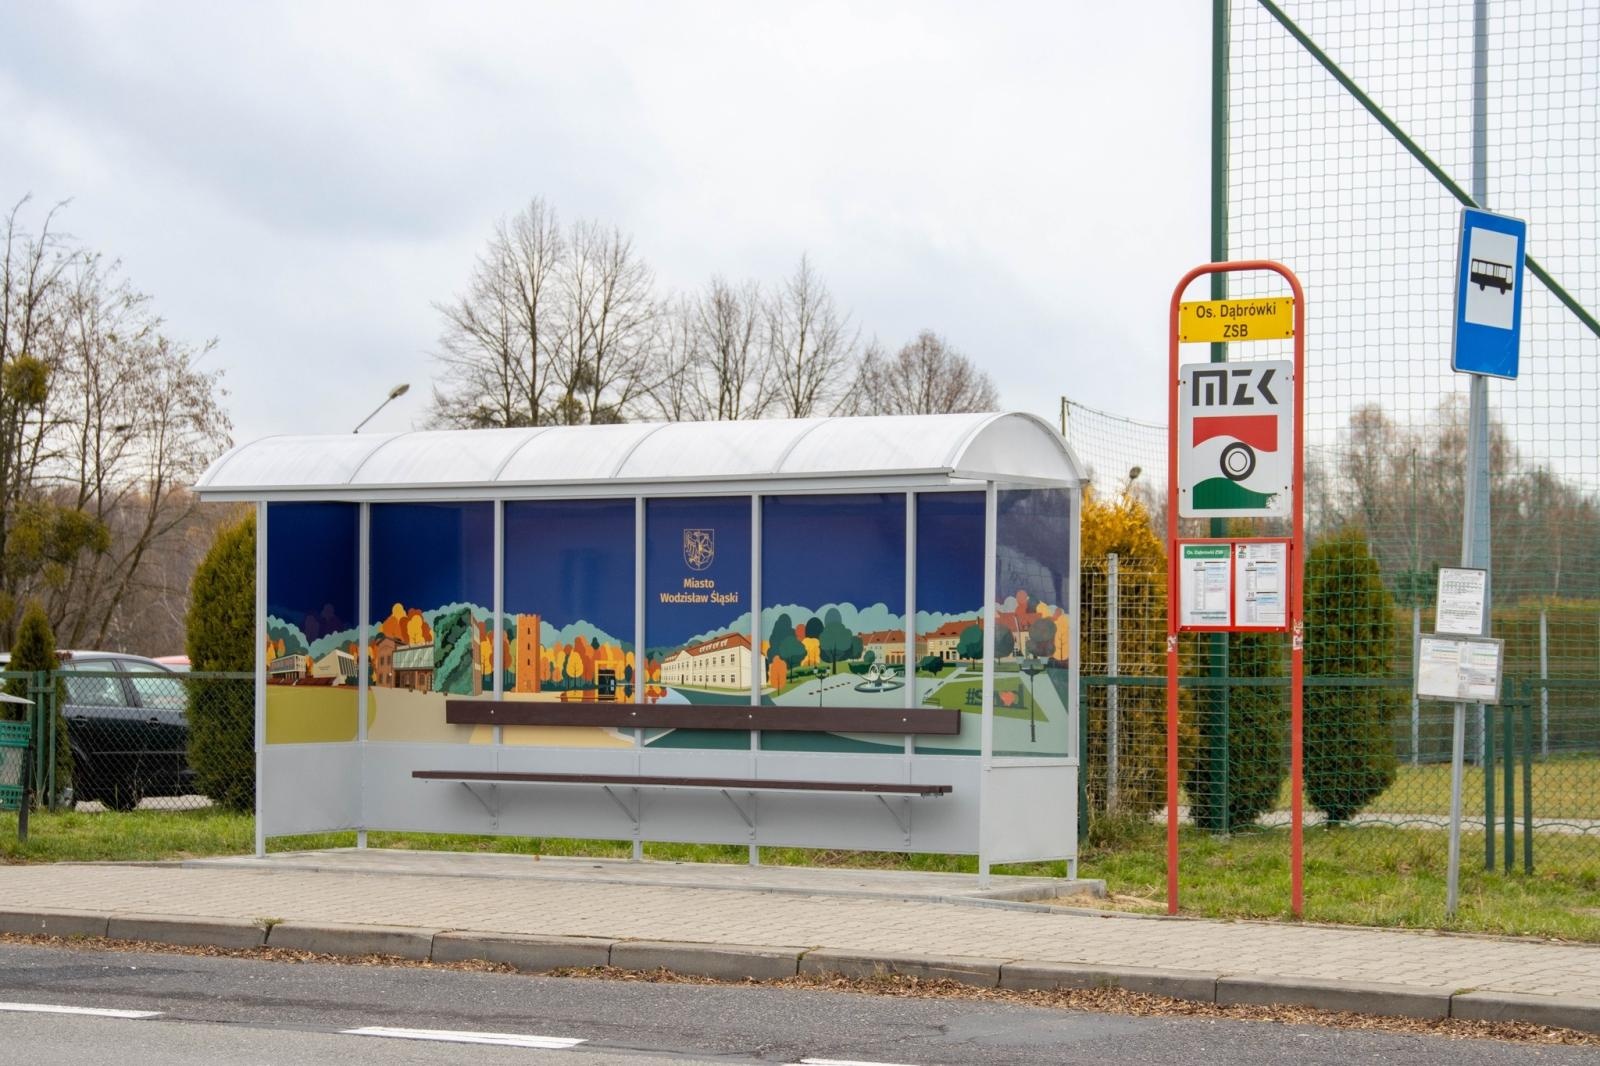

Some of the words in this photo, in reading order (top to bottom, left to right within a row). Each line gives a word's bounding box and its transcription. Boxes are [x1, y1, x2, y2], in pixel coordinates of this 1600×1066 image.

[1195, 305, 1216, 318] Os.
[1220, 302, 1277, 321] Dąbrówki
[1223, 324, 1248, 338] ZSB
[1192, 369, 1279, 406] MZK
[683, 577, 715, 588] Miasto
[660, 592, 709, 603] Wodzisław
[710, 590, 739, 606] Śląski
